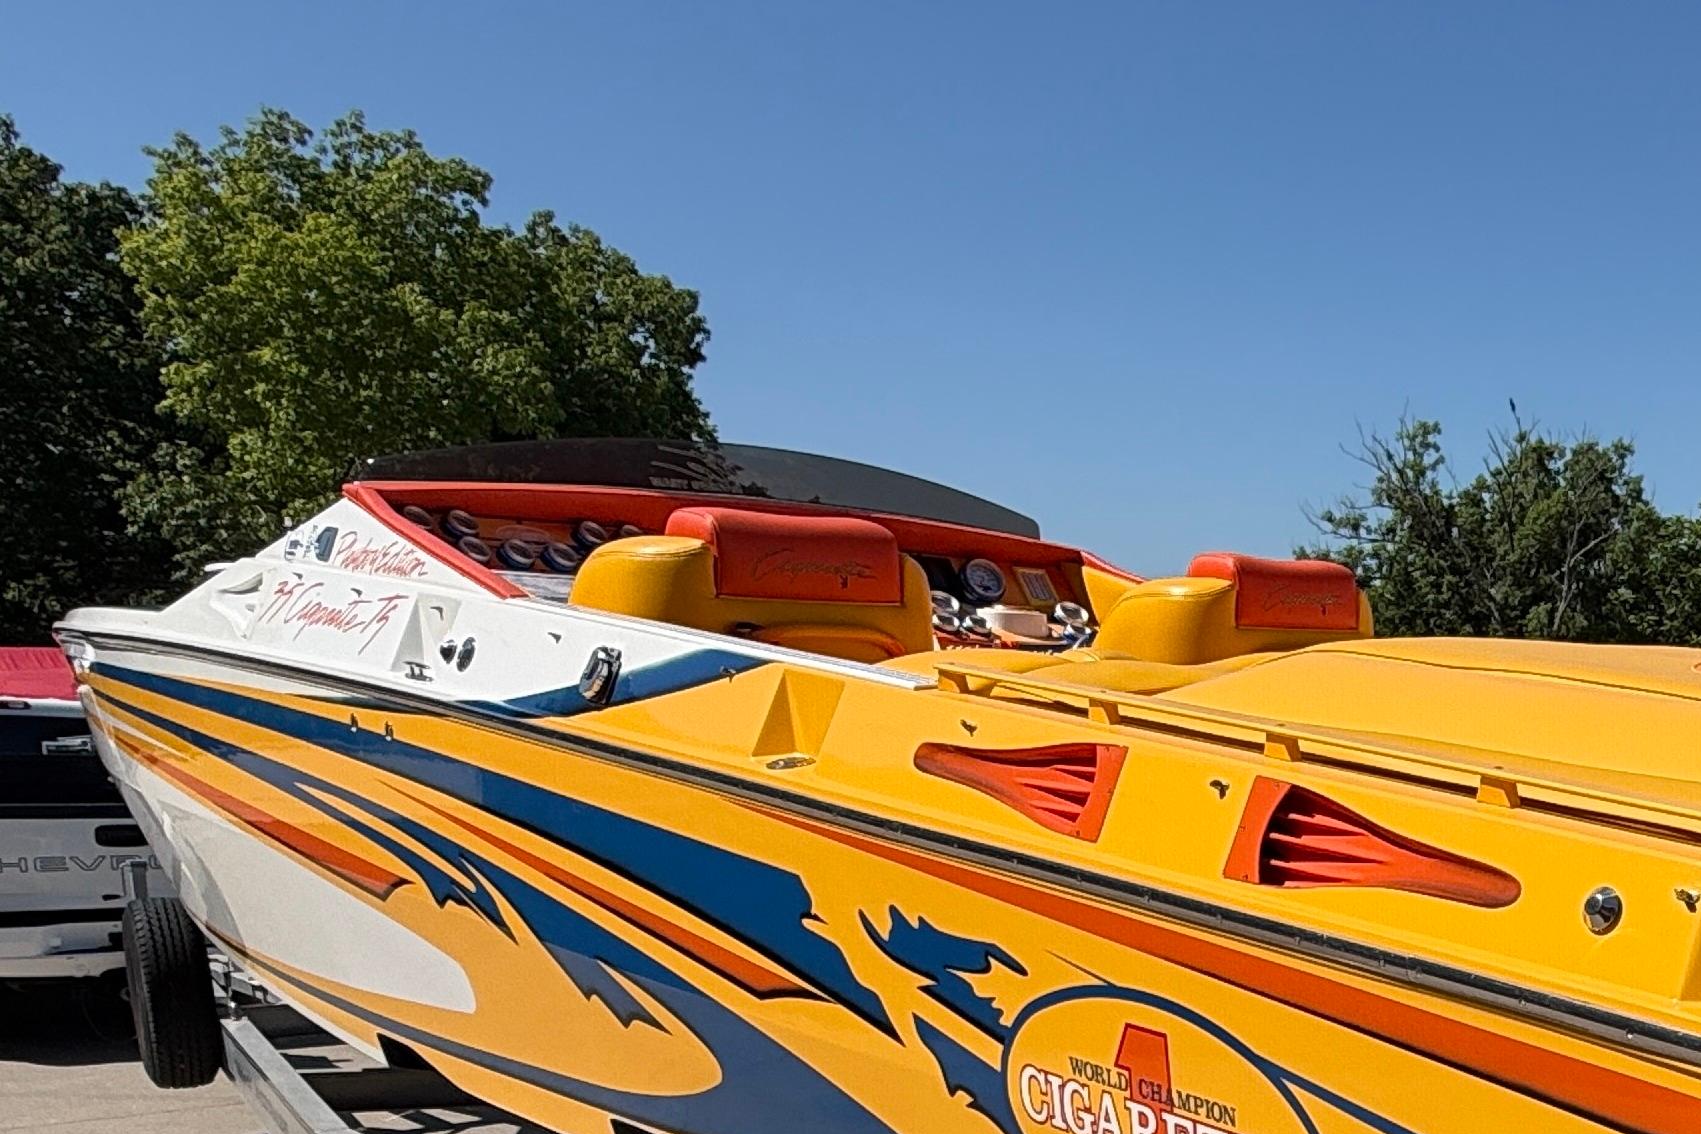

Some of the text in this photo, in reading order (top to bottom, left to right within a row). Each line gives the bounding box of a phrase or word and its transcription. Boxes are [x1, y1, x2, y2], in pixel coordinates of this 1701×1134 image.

[258, 581, 304, 624] 35
[1069, 1056, 1236, 1127] WORLD CHAMPION
